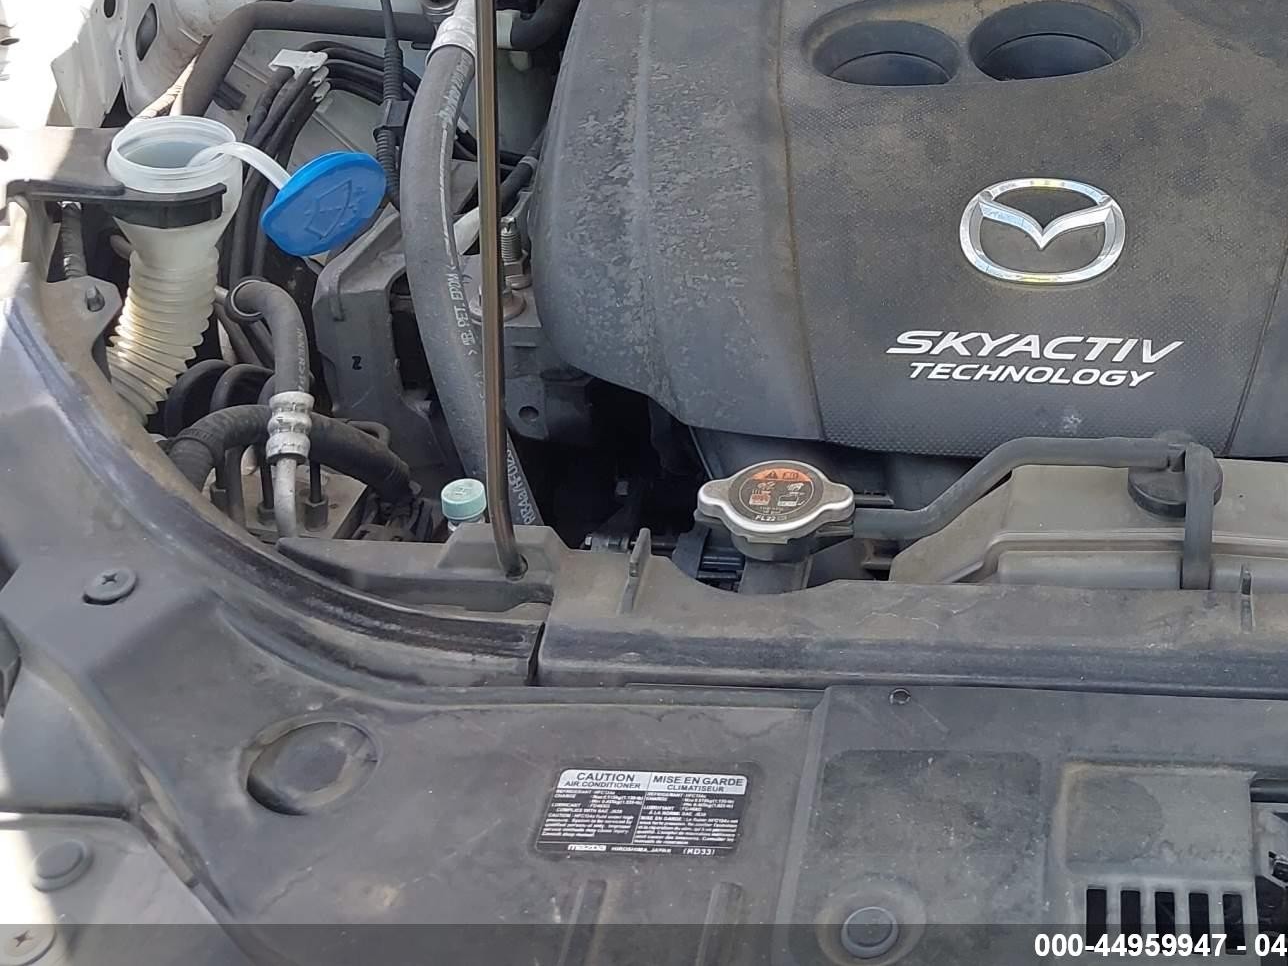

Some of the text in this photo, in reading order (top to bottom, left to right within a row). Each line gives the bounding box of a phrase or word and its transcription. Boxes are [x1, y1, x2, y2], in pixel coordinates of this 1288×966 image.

[886, 330, 1186, 365] SKYACTIV
[908, 361, 1156, 388] TECHNOLOGY
[576, 772, 635, 782] CAUTION
[653, 775, 744, 787] MISE EN GARDE
[582, 781, 641, 789] CONDITIONER
[666, 784, 725, 793] CLIMATISEUR
